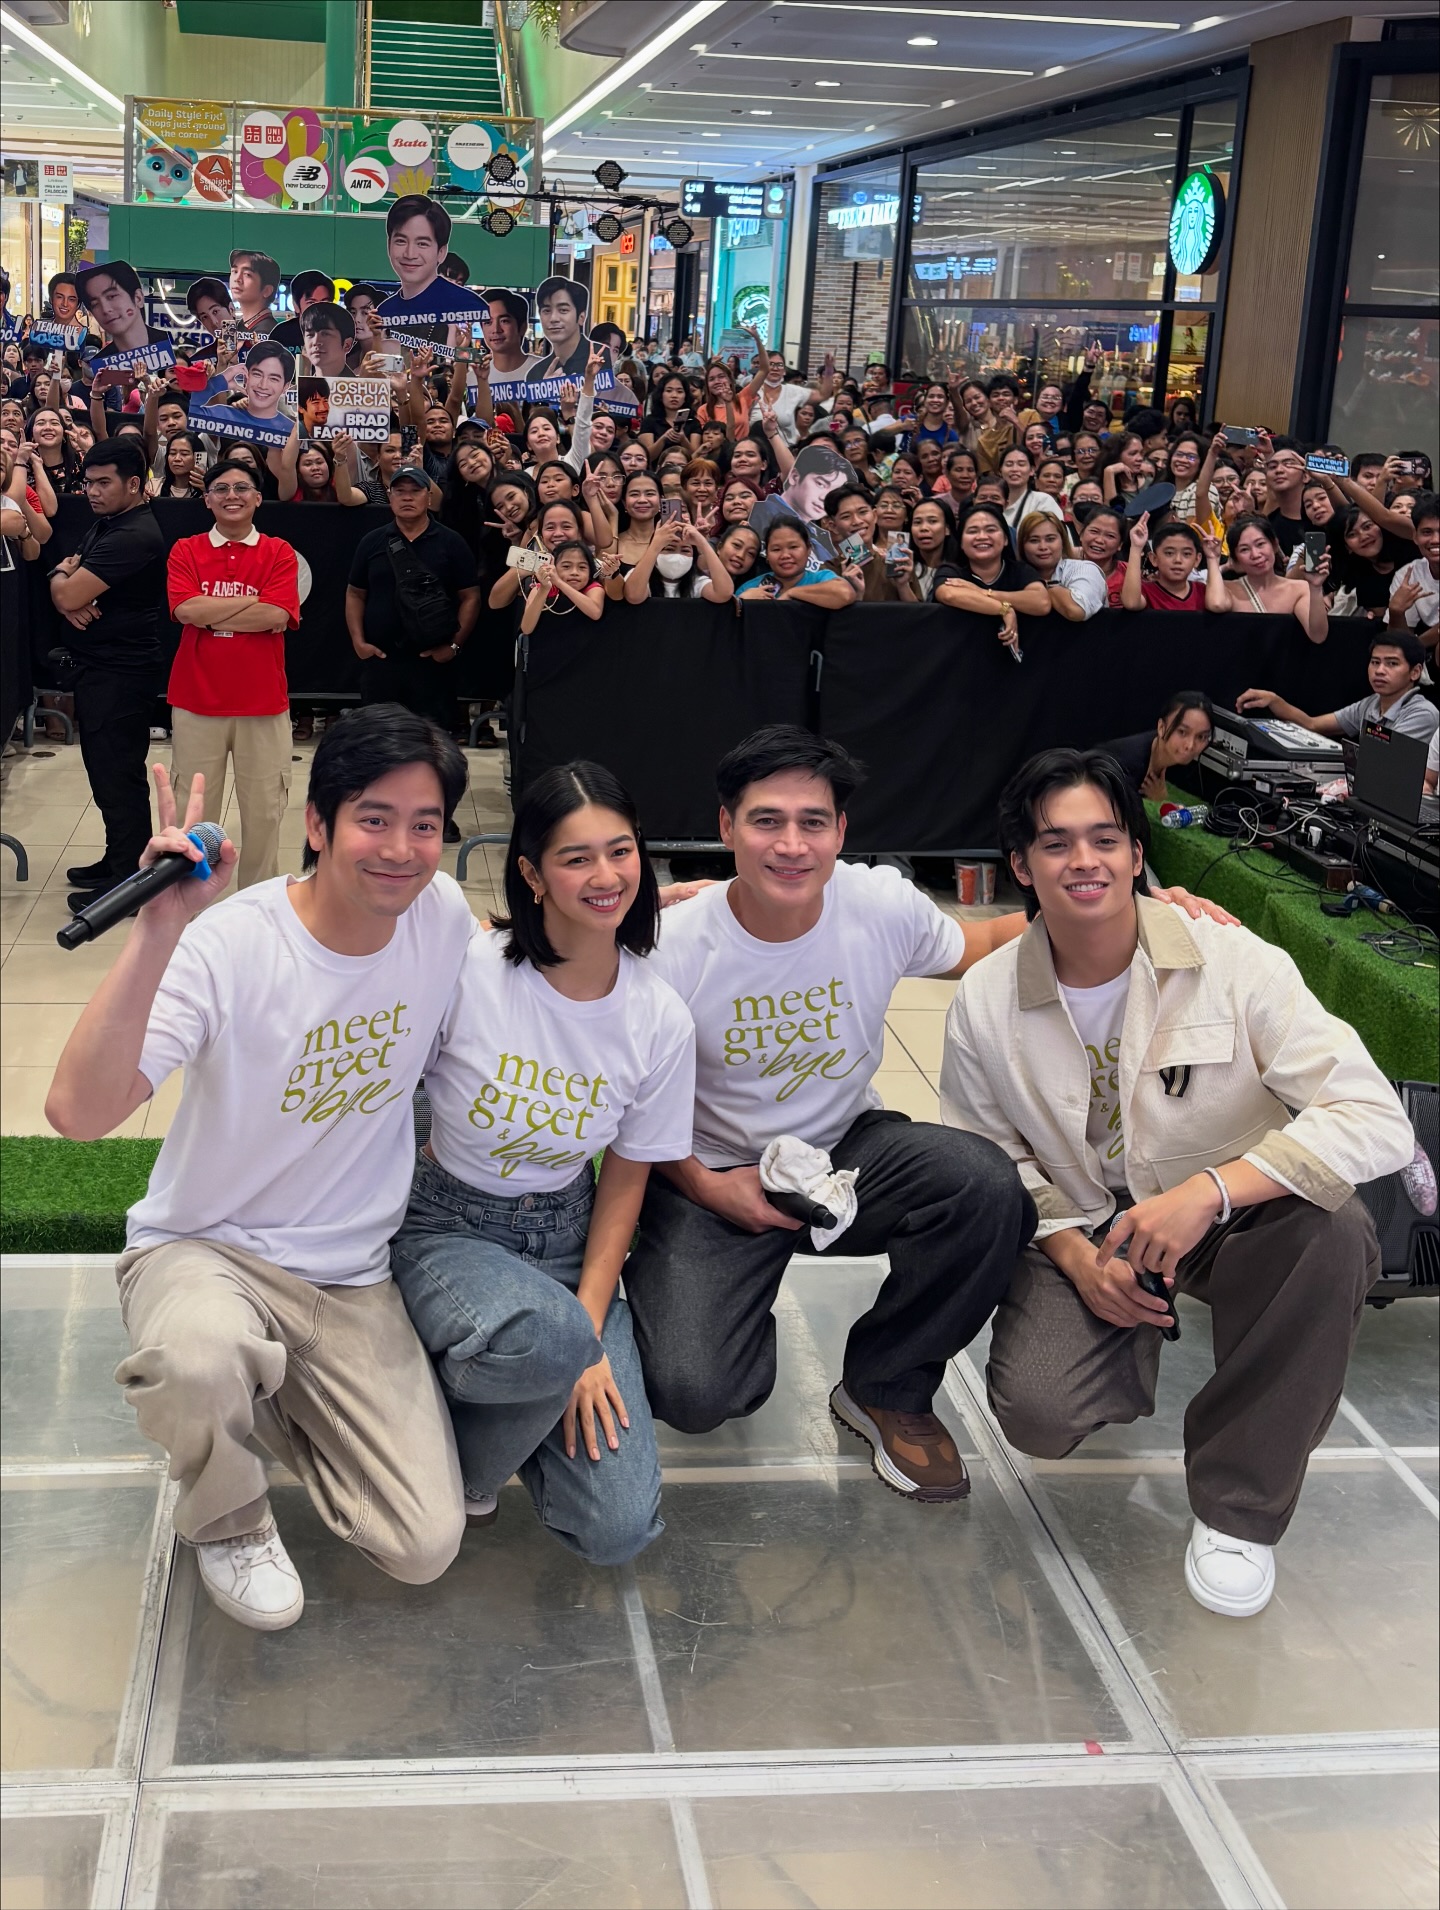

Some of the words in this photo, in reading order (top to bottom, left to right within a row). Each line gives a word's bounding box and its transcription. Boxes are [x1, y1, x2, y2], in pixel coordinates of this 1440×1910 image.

[148, 109, 173, 119] Daily
[176, 110, 201, 121] Style
[204, 112, 223, 120] Fix!
[143, 119, 171, 128] Shops
[173, 121, 191, 129] just
[178, 131, 208, 139] corner
[392, 138, 428, 148] Bata
[299, 182, 326, 190] balance
[350, 179, 372, 189] ANTA
[487, 179, 526, 188] CASIO
[440, 310, 491, 323] JOSHUA
[102, 344, 159, 366] TROPANG
[330, 382, 389, 395] JOSHUA
[574, 371, 612, 393] JOHUA
[330, 393, 389, 406] GARCIA
[345, 413, 389, 427] BRAD
[188, 416, 254, 440] TROPANG
[731, 976, 853, 1023] meet,
[300, 999, 411, 1060] meet,
[723, 1009, 840, 1067] greet
[758, 1052, 768, 1064] &
[758, 1030, 870, 1102] bye
[280, 1036, 396, 1113] greet
[493, 1052, 609, 1112] meet,
[468, 1083, 594, 1140] greet
[497, 1128, 511, 1141] &
